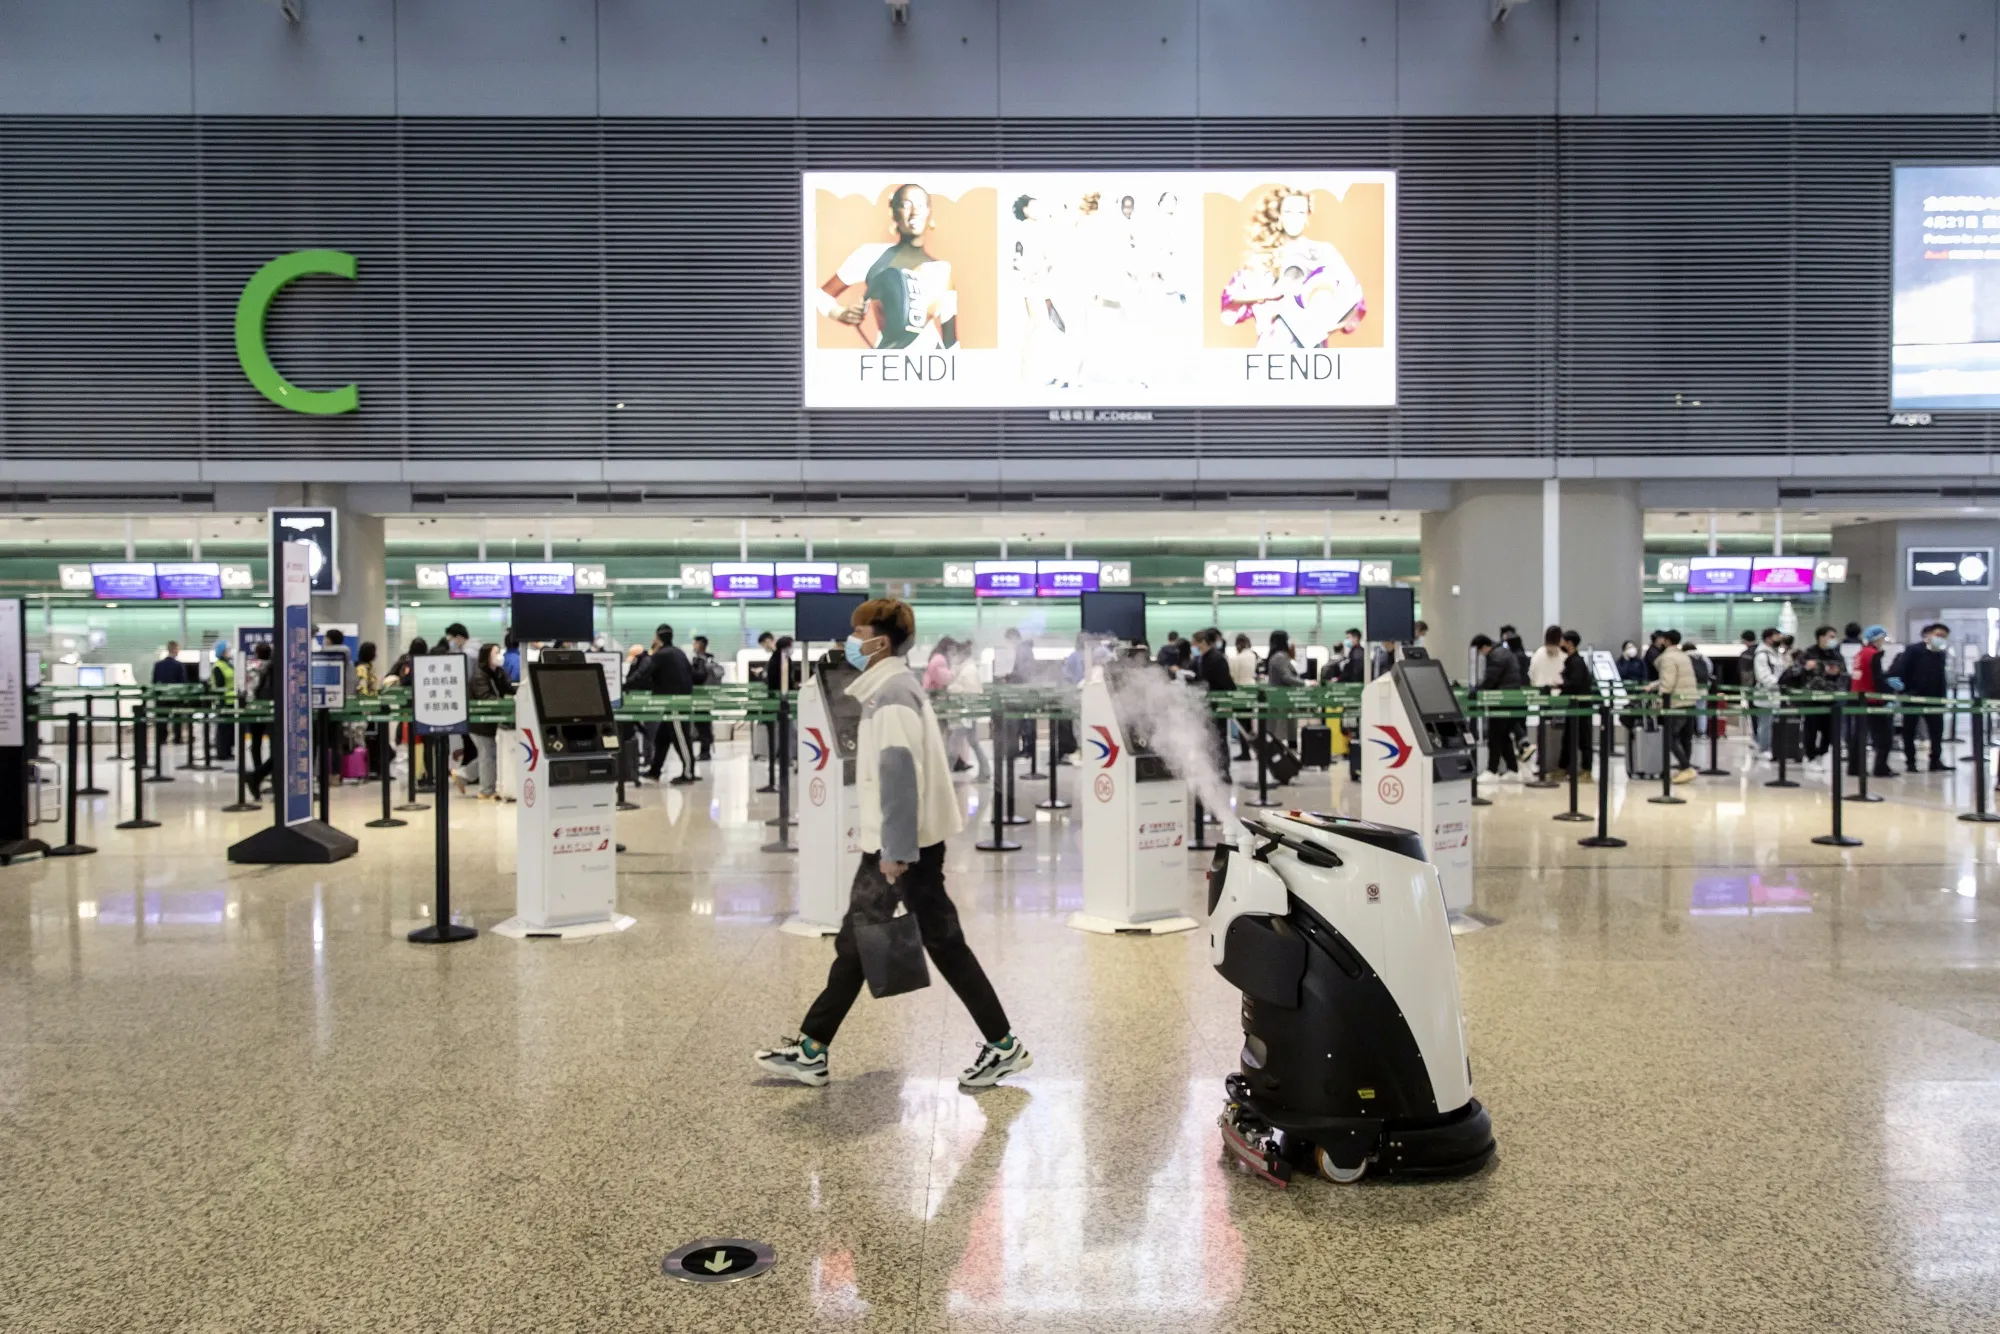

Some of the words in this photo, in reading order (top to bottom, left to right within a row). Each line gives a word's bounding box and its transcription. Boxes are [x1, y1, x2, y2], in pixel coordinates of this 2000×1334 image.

[235, 249, 359, 415] C
[860, 355, 955, 381] FENDI
[1246, 353, 1341, 380] FENDI
[1382, 782, 1400, 798] 05
